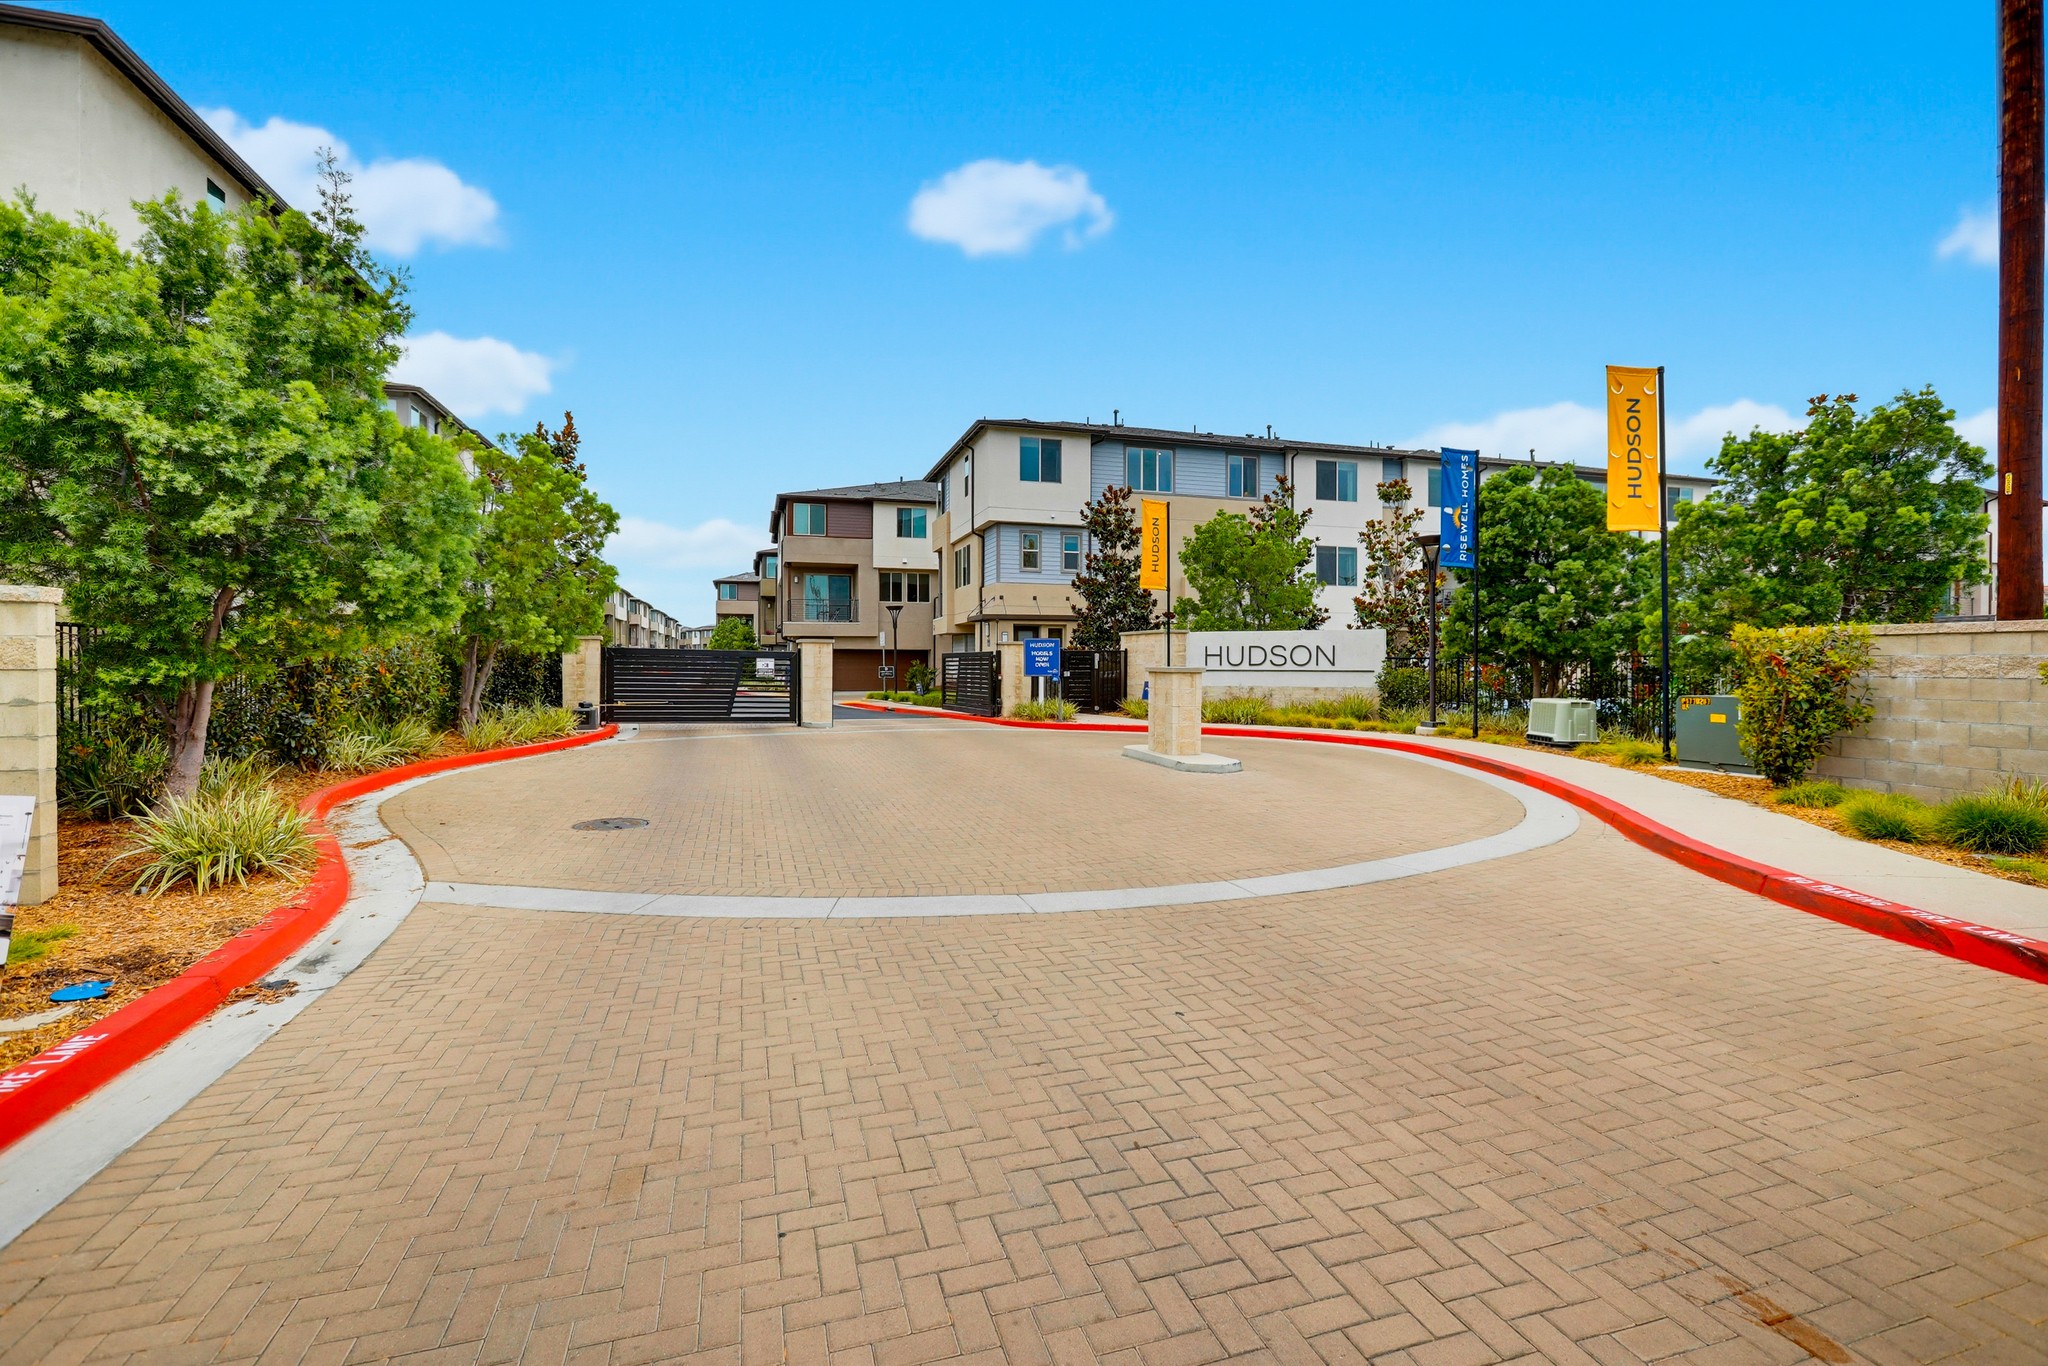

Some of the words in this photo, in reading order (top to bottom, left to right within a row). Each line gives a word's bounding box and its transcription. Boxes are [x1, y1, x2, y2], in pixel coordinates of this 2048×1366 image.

[1461, 455, 1470, 498] HOMES
[1626, 398, 1643, 499] HUDSON
[1151, 517, 1160, 573] HUDSON
[1460, 502, 1469, 562] RISEWELL
[1204, 645, 1336, 667] HUDSON
[1810, 884, 1893, 906] PARKING
[1900, 909, 1963, 925] FIRE
[1960, 926, 2038, 944] LANE
[0, 1069, 47, 1092] RE
[29, 1033, 110, 1065] LANE
